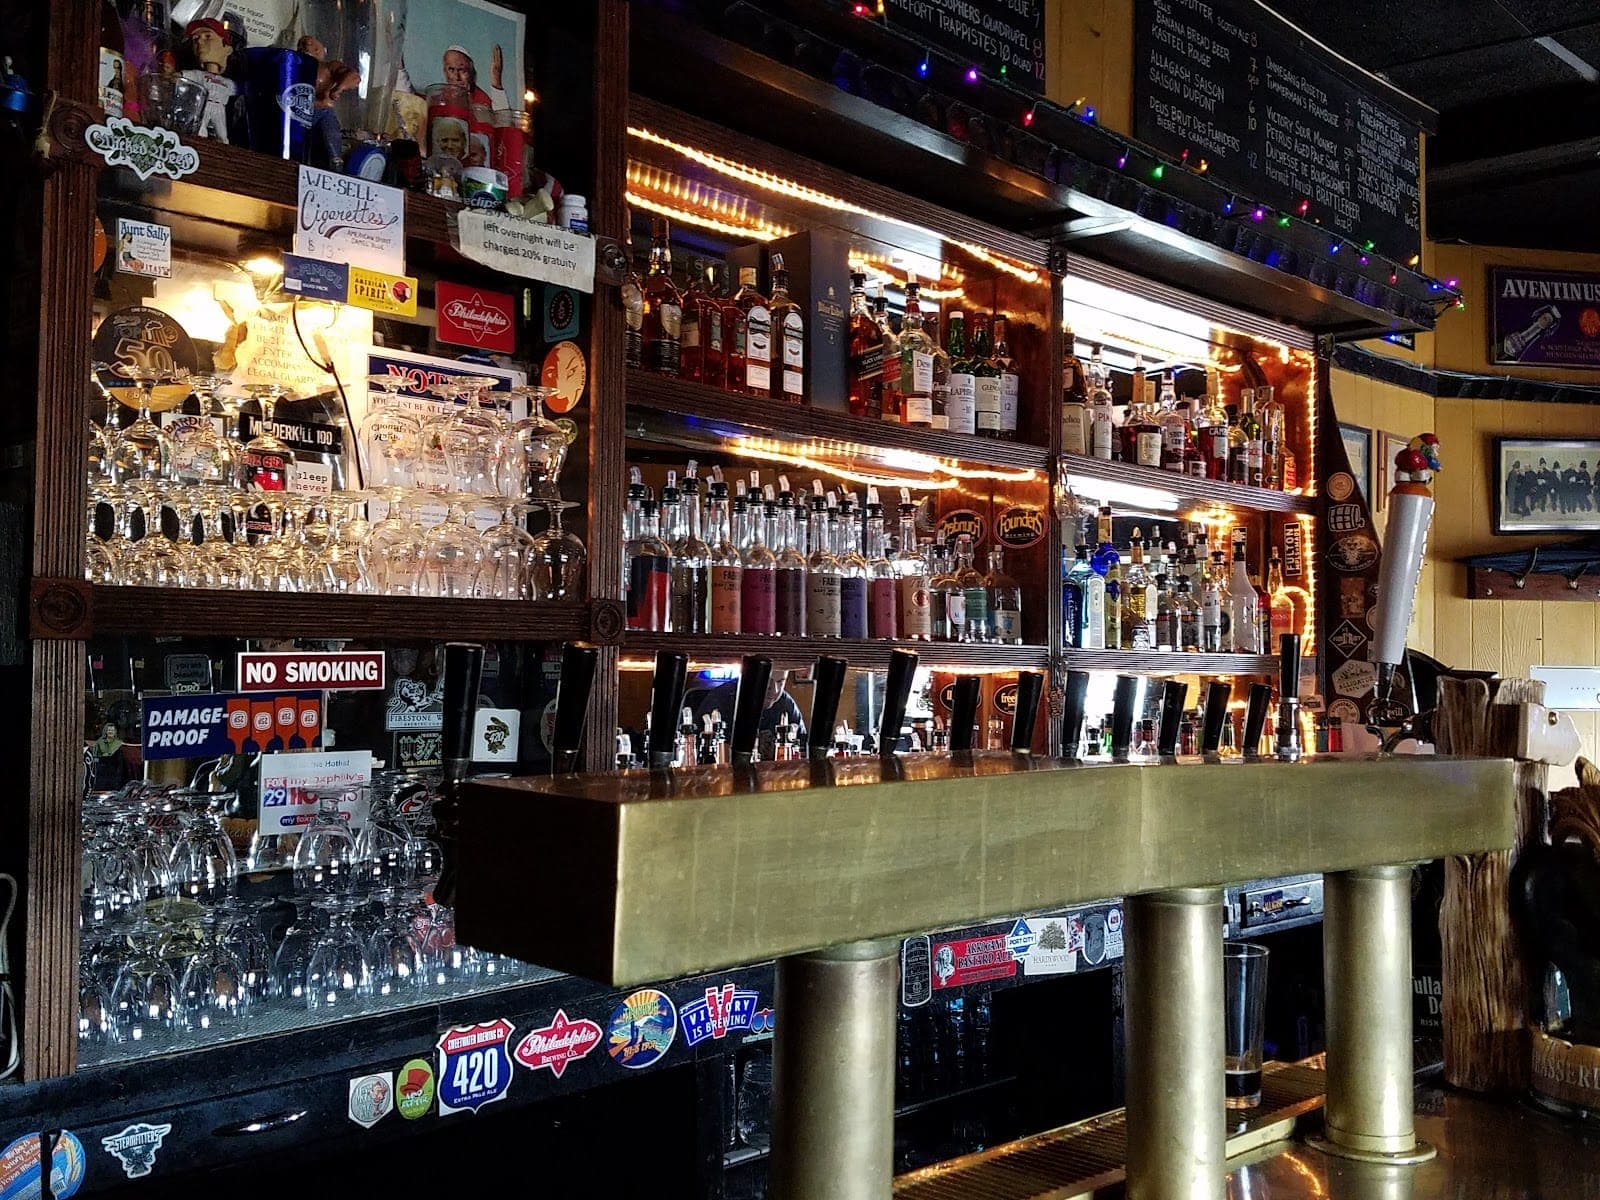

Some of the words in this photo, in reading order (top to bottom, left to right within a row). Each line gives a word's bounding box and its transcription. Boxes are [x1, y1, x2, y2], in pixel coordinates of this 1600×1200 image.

[1156, 10, 1186, 36] BANANA
[1187, 26, 1210, 51] BREAD
[1211, 41, 1231, 63] BEER
[1150, 49, 1191, 83] ALLAGASH
[1149, 67, 1181, 94] SAISON
[305, 170, 332, 192] WE
[337, 178, 374, 203] SELL
[301, 189, 400, 237] Cigarettes
[464, 195, 503, 210] eclips
[120, 221, 146, 236] Aunt
[146, 225, 171, 247] Sally
[483, 220, 500, 234] left
[500, 226, 545, 245] overnight
[546, 236, 561, 249] will
[563, 240, 576, 253] be
[483, 239, 520, 257] charged
[521, 248, 541, 263] 20%
[543, 253, 577, 270] gratuity
[354, 284, 387, 301] SPIRIT
[1502, 278, 1600, 303] AVENTINUS
[448, 302, 508, 328] Philadelphia
[109, 337, 174, 380] 50
[249, 415, 314, 445] MUDERKILL
[316, 429, 333, 446] 100
[999, 512, 1043, 537] Founders
[1285, 528, 1296, 572] FULTON
[246, 662, 278, 684] NO
[285, 661, 378, 684] SMOKING
[148, 707, 230, 728] DAMAGE-
[390, 714, 431, 723] FIRESTONE
[148, 729, 210, 748] PROOF
[265, 788, 287, 806] 29
[690, 1000, 751, 1026] VICTORY
[523, 1027, 597, 1057] Philadelphia
[692, 1029, 704, 1043] IS
[705, 1015, 747, 1037] BREWING
[452, 1047, 499, 1096] 420
